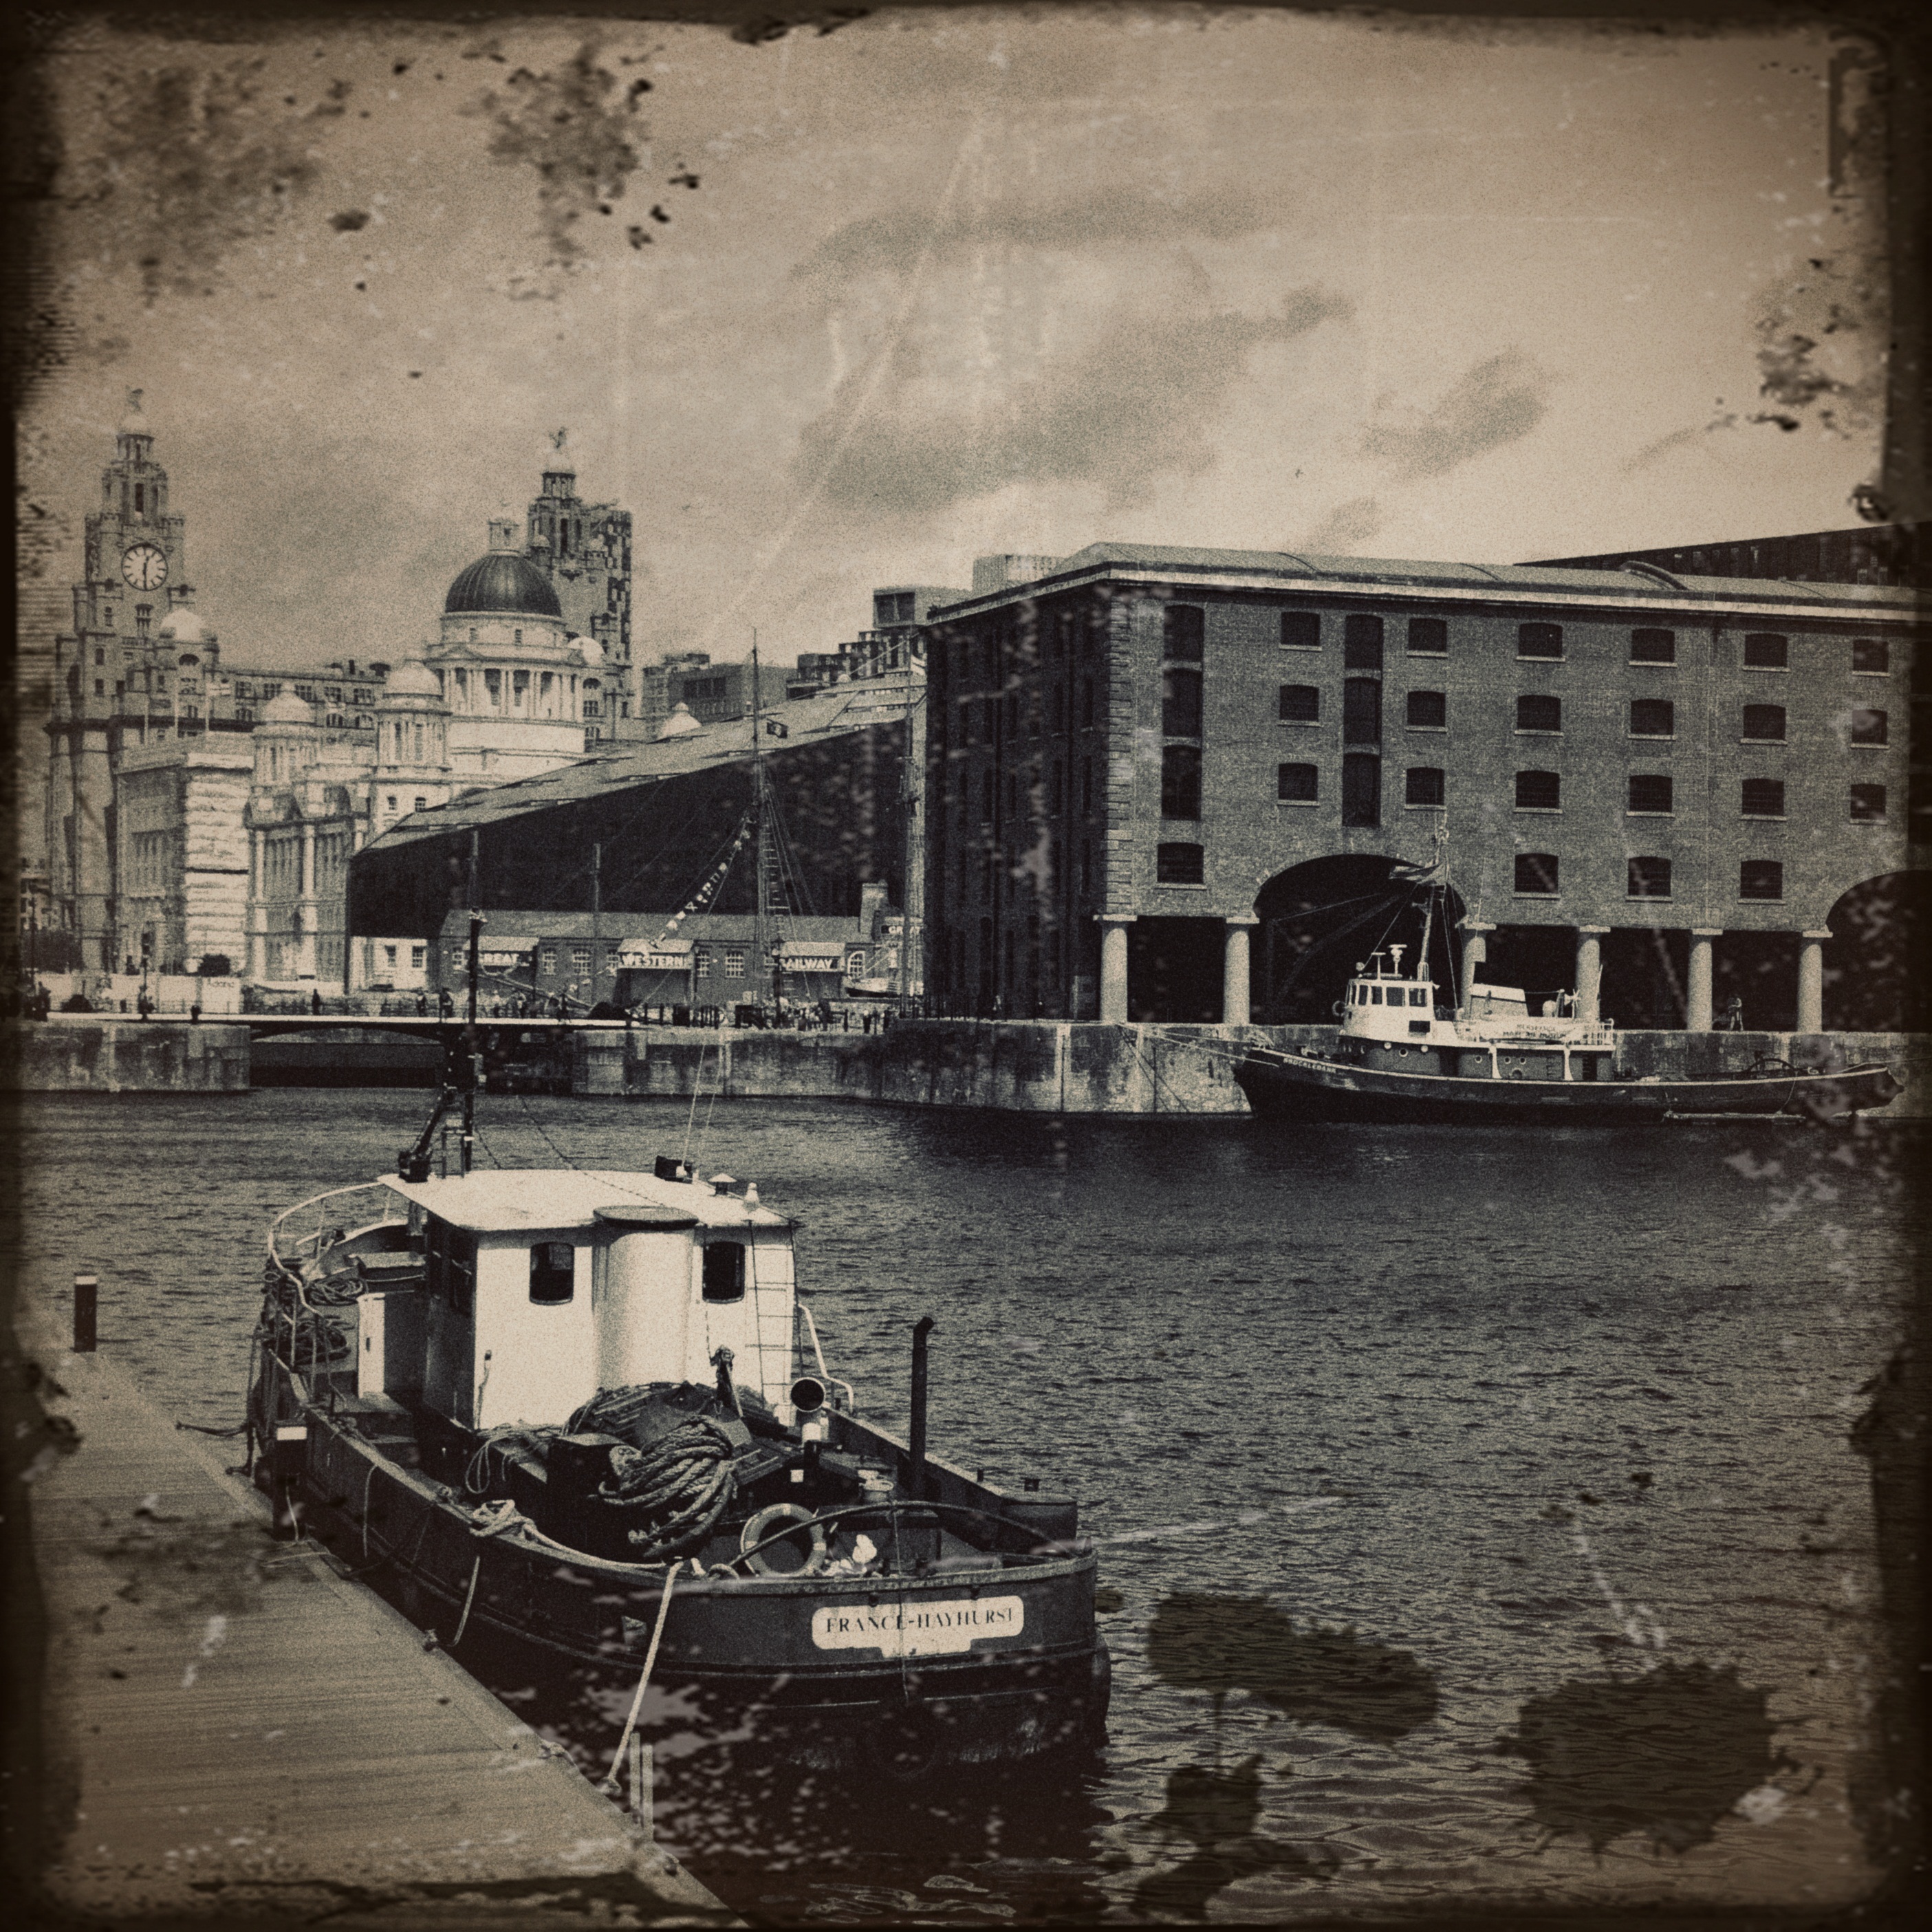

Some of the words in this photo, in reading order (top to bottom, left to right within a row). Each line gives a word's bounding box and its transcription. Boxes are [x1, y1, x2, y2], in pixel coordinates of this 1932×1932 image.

[888, 926, 920, 935] GRAT
[622, 954, 684, 967] WESTERN
[779, 958, 833, 969] RAILWAY
[826, 1607, 1014, 1633] FRANCE-HAYHURST
